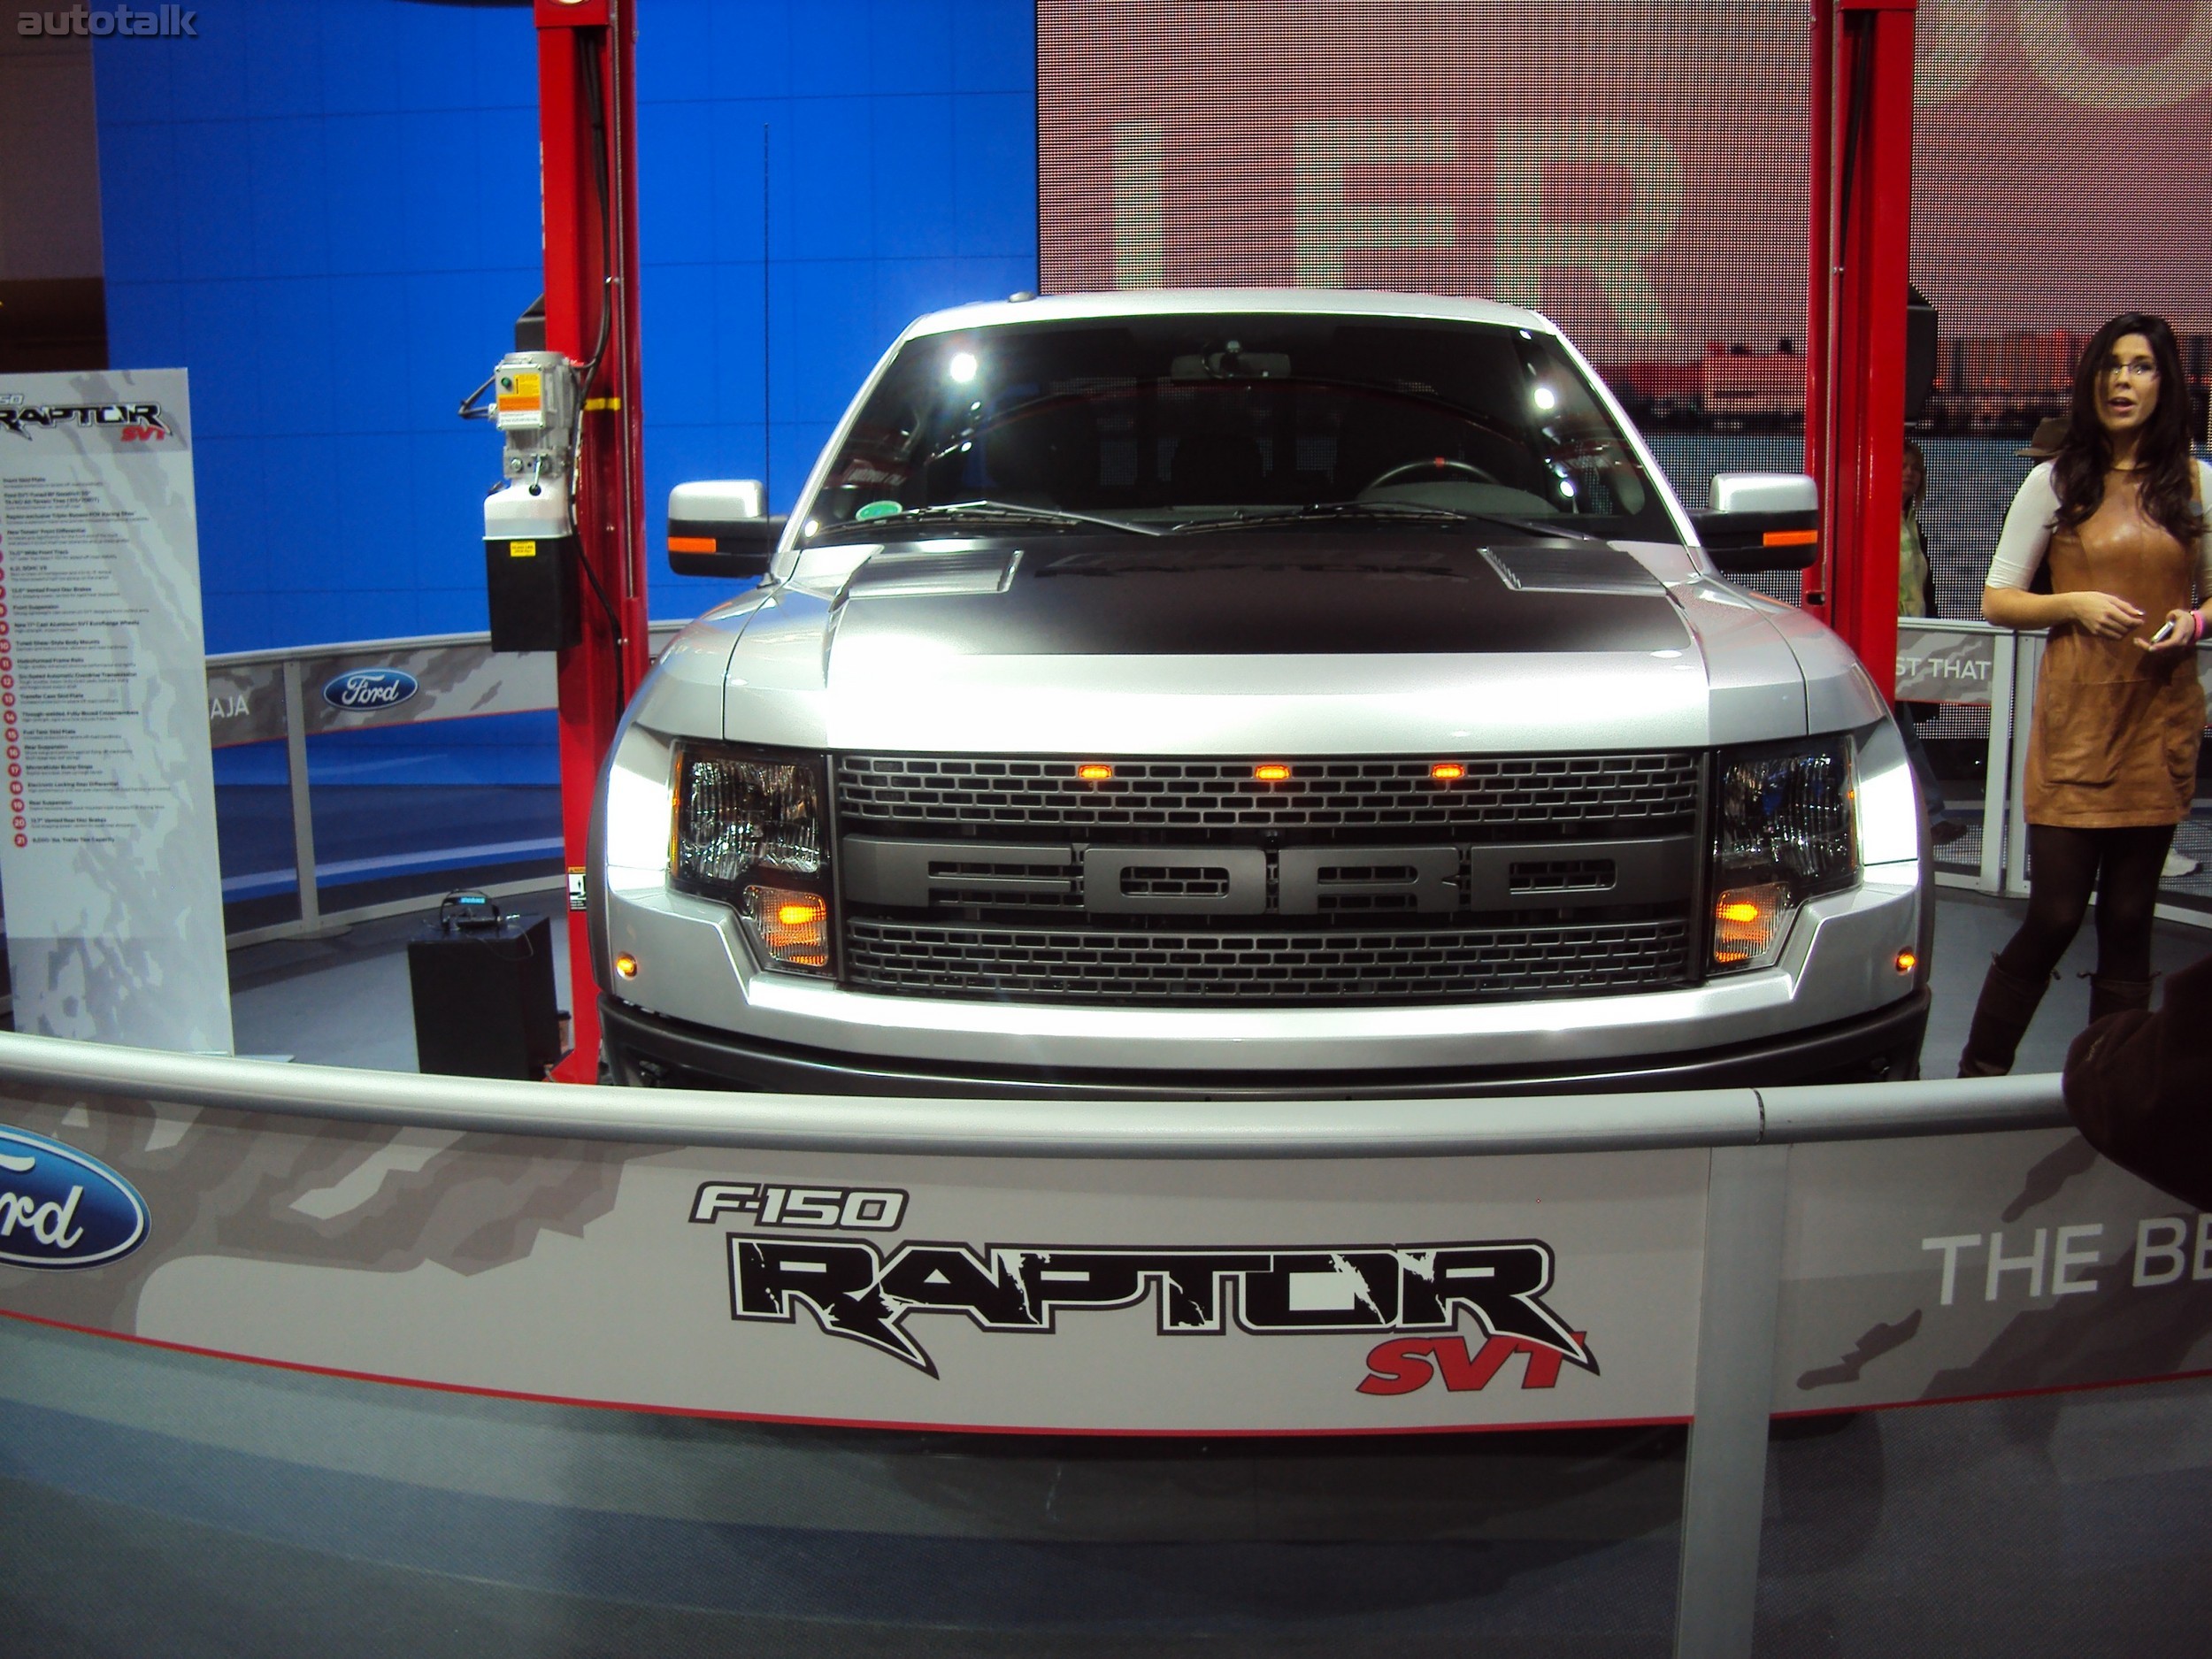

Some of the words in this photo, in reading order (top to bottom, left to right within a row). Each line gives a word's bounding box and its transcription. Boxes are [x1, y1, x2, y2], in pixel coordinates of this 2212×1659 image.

[342, 674, 400, 705] Ford
[1928, 658, 1992, 680] THAT
[843, 834, 1686, 918] FORD
[0, 1154, 84, 1249] rd
[690, 1181, 909, 1232] F-150
[1922, 1224, 2104, 1305] THE
[726, 1233, 1600, 1380] RAPTOR
[1356, 1332, 1586, 1395] SVT
